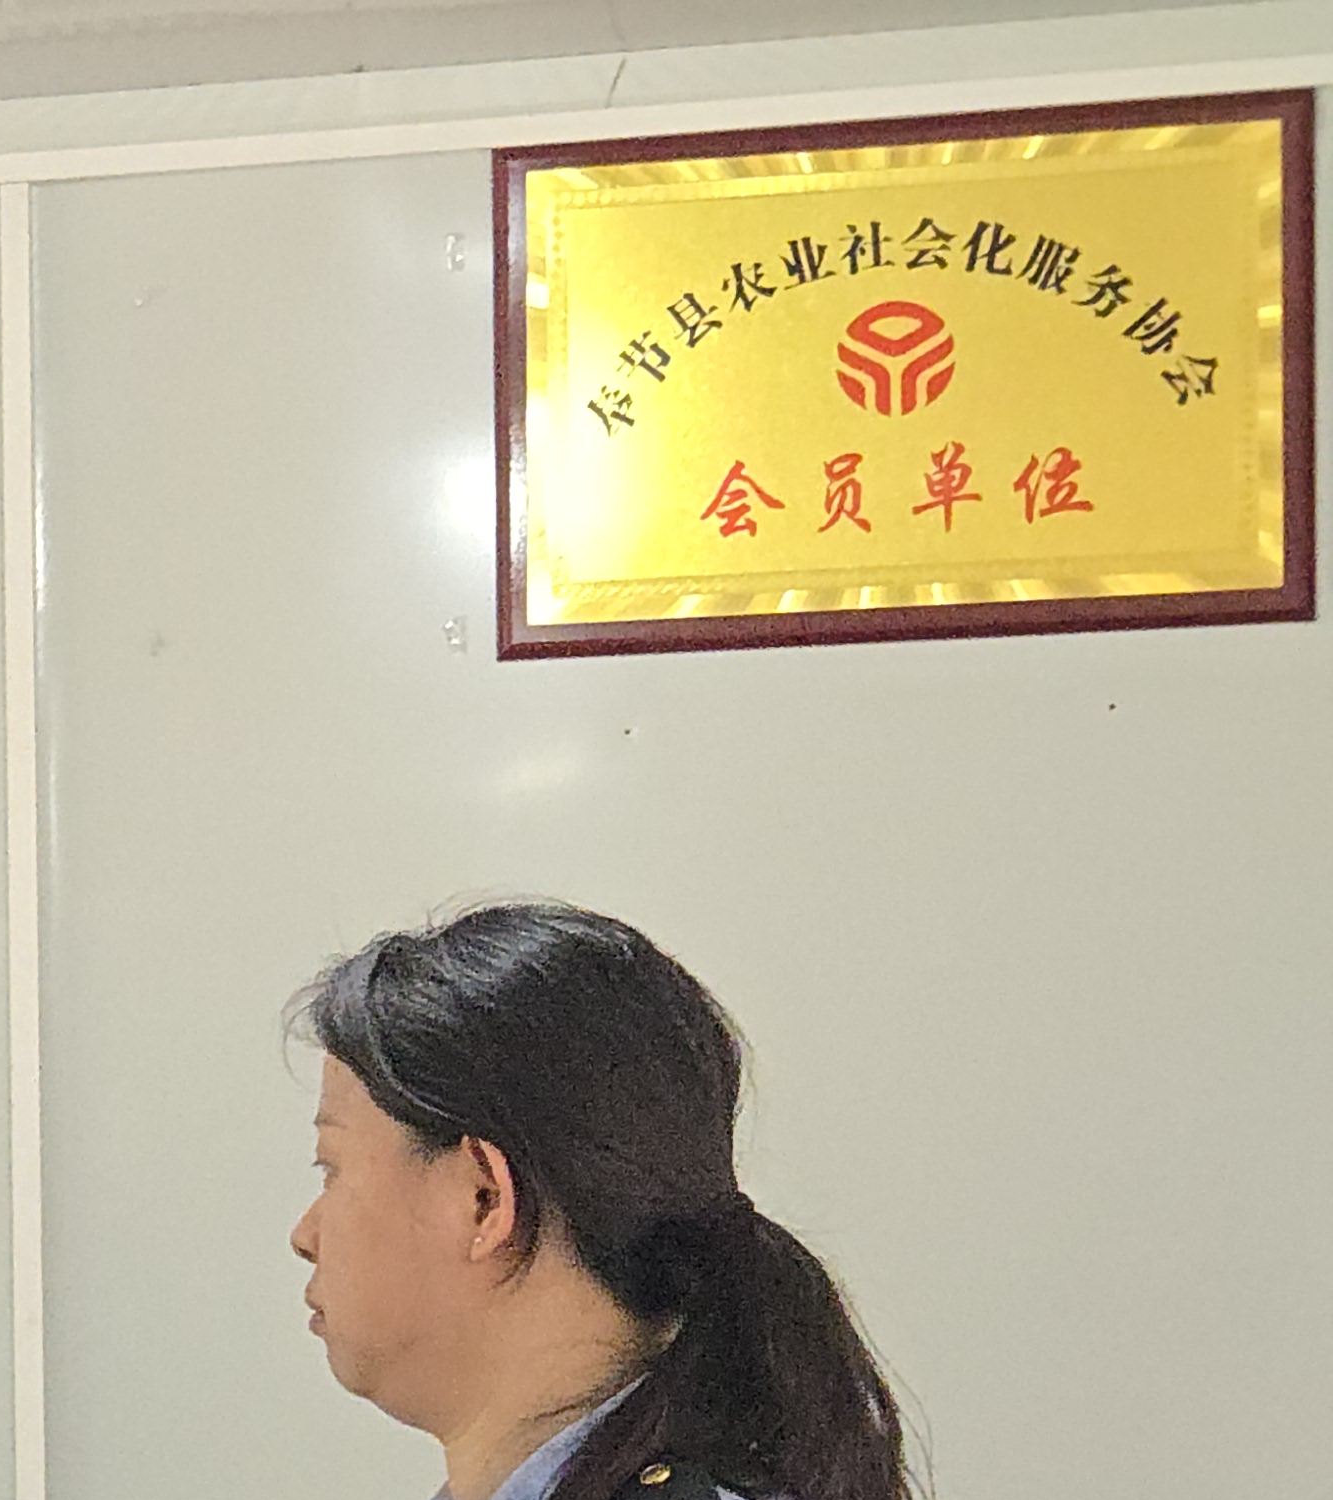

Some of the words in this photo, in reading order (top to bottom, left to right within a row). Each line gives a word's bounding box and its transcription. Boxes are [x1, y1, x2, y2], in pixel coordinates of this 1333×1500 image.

[585, 215, 1223, 440] 奉节县农业社会化服务协会
[699, 438, 1095, 538] 会员单位
